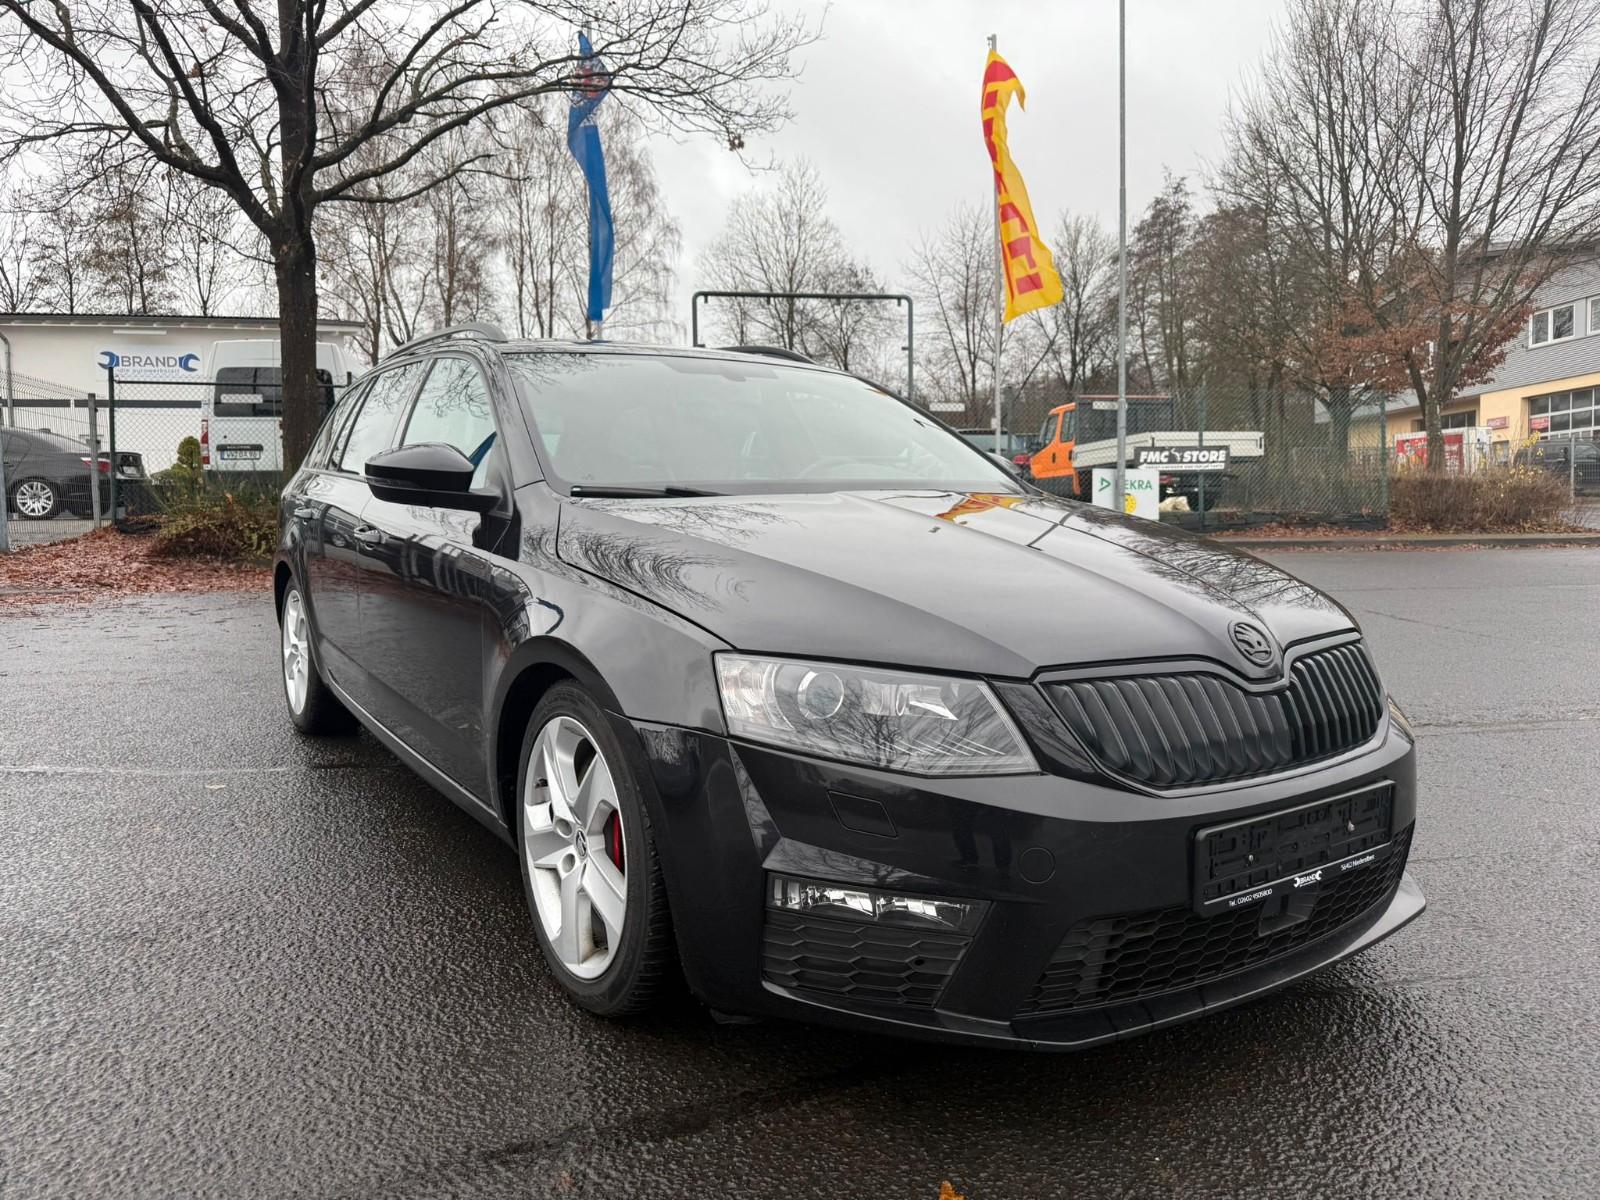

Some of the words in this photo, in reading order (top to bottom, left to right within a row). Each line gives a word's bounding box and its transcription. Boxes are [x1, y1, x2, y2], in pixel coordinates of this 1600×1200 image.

[121, 356, 178, 367] BRAND
[1140, 451, 1169, 463] FMC
[1182, 450, 1227, 463] STORE
